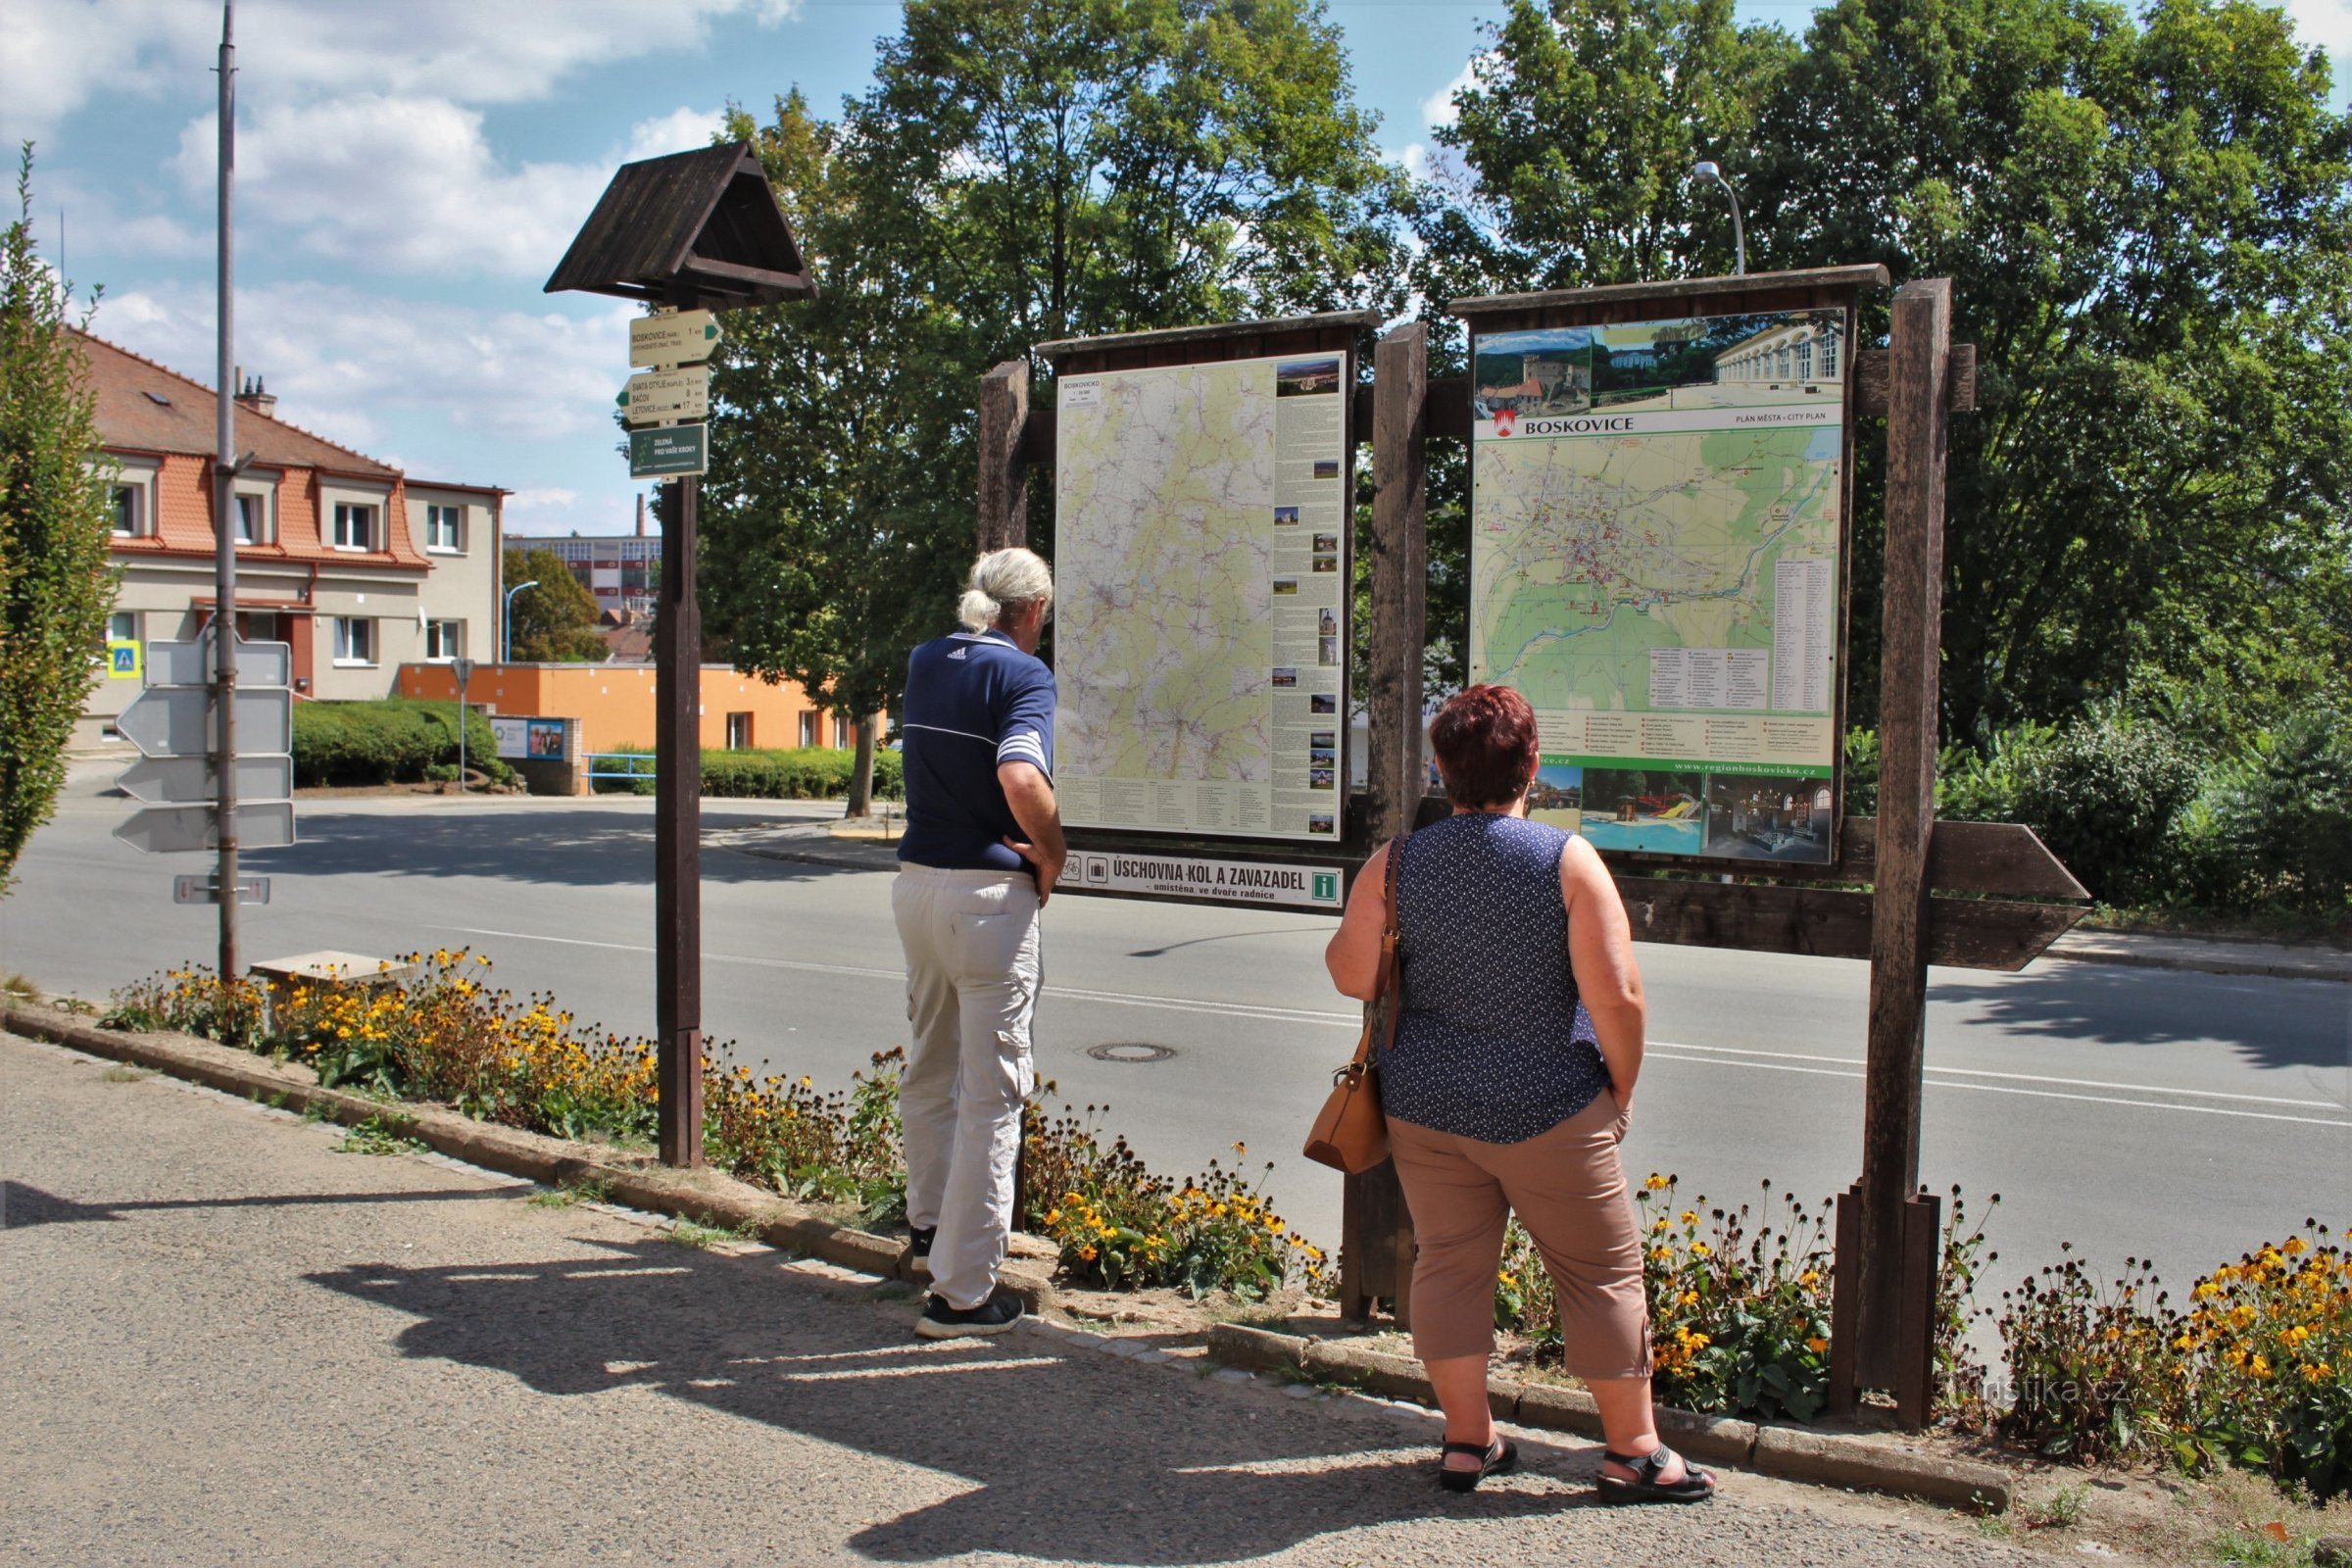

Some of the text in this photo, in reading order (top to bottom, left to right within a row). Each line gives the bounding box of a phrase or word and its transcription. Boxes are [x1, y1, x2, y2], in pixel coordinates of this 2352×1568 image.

[632, 330, 667, 343] BOSKOVICE
[688, 326, 692, 336] 1
[1064, 380, 1100, 390] BOSKOVICKO
[632, 393, 650, 404] BAČOV
[632, 404, 657, 416] LETOVICE
[1757, 414, 1782, 422] MĚSTA
[1788, 413, 1804, 421] CITY
[1525, 417, 1634, 434] BOSKOVICE
[655, 436, 672, 446] ZELENÁ
[665, 446, 678, 455] VAŠE
[678, 445, 696, 454] KROKY
[1674, 762, 1816, 776] www.regionboskovicko.cz
[1113, 856, 1305, 891] ÚSCHOVNA KOL A ZAVAZADEL
[1211, 886, 1238, 897] dvoře
[1240, 889, 1275, 900] radnice
